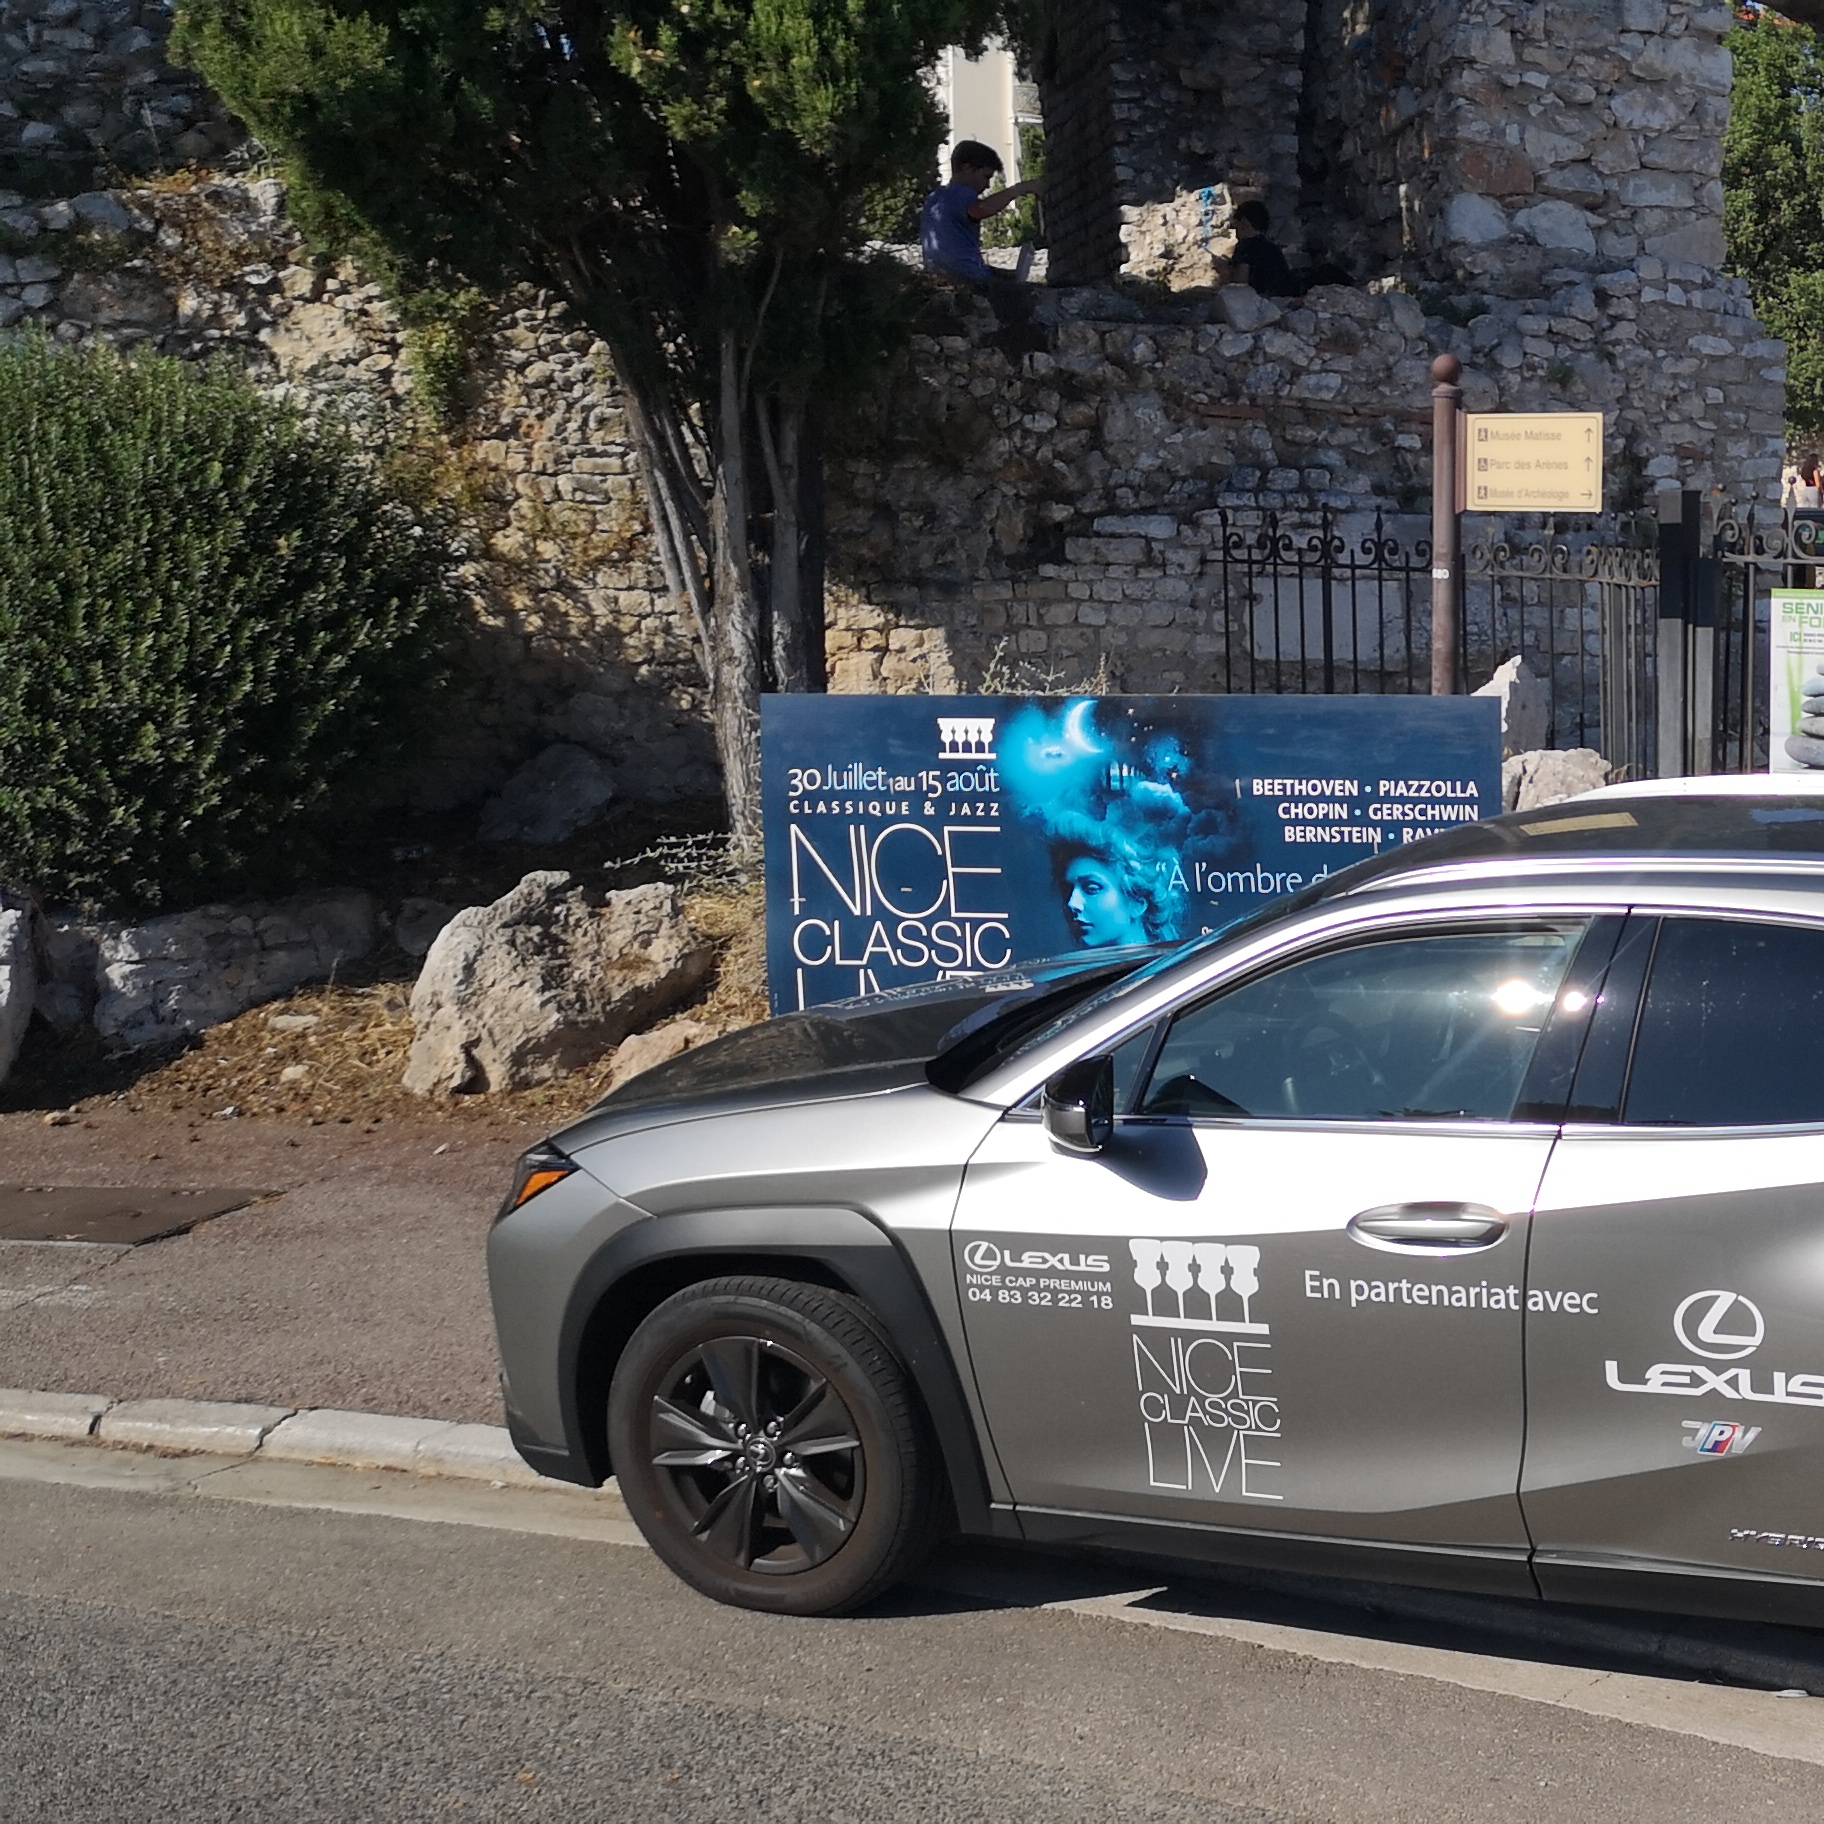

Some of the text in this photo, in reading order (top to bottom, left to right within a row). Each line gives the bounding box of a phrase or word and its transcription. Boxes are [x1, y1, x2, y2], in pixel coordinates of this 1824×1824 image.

[1490, 430, 1562, 441] Musée Matisse
[1490, 459, 1568, 469] Parc des Arènes
[787, 762, 1000, 798] 30 Juillet au 15 août
[1252, 778, 1479, 798] BEETHOVEN PIAZZOLLA
[789, 800, 1000, 817] CLASSIQUE & JAZZ
[1278, 802, 1479, 821] CHOPIN GERSCHWIN
[1284, 826, 1382, 844] BERNSTEIN
[790, 822, 1009, 919] NICE
[793, 918, 1012, 969] CLASSIC
[1004, 1250, 1110, 1273] LEXUS
[966, 1274, 1112, 1293] NICE CAP PREMIUM
[1304, 1270, 1599, 1314] En partenariat avec
[968, 1288, 1113, 1310] 04 83 32 22 18
[1132, 1333, 1278, 1401] NICE
[1140, 1392, 1281, 1431] CLASSIC
[1144, 1421, 1283, 1499] LIVE
